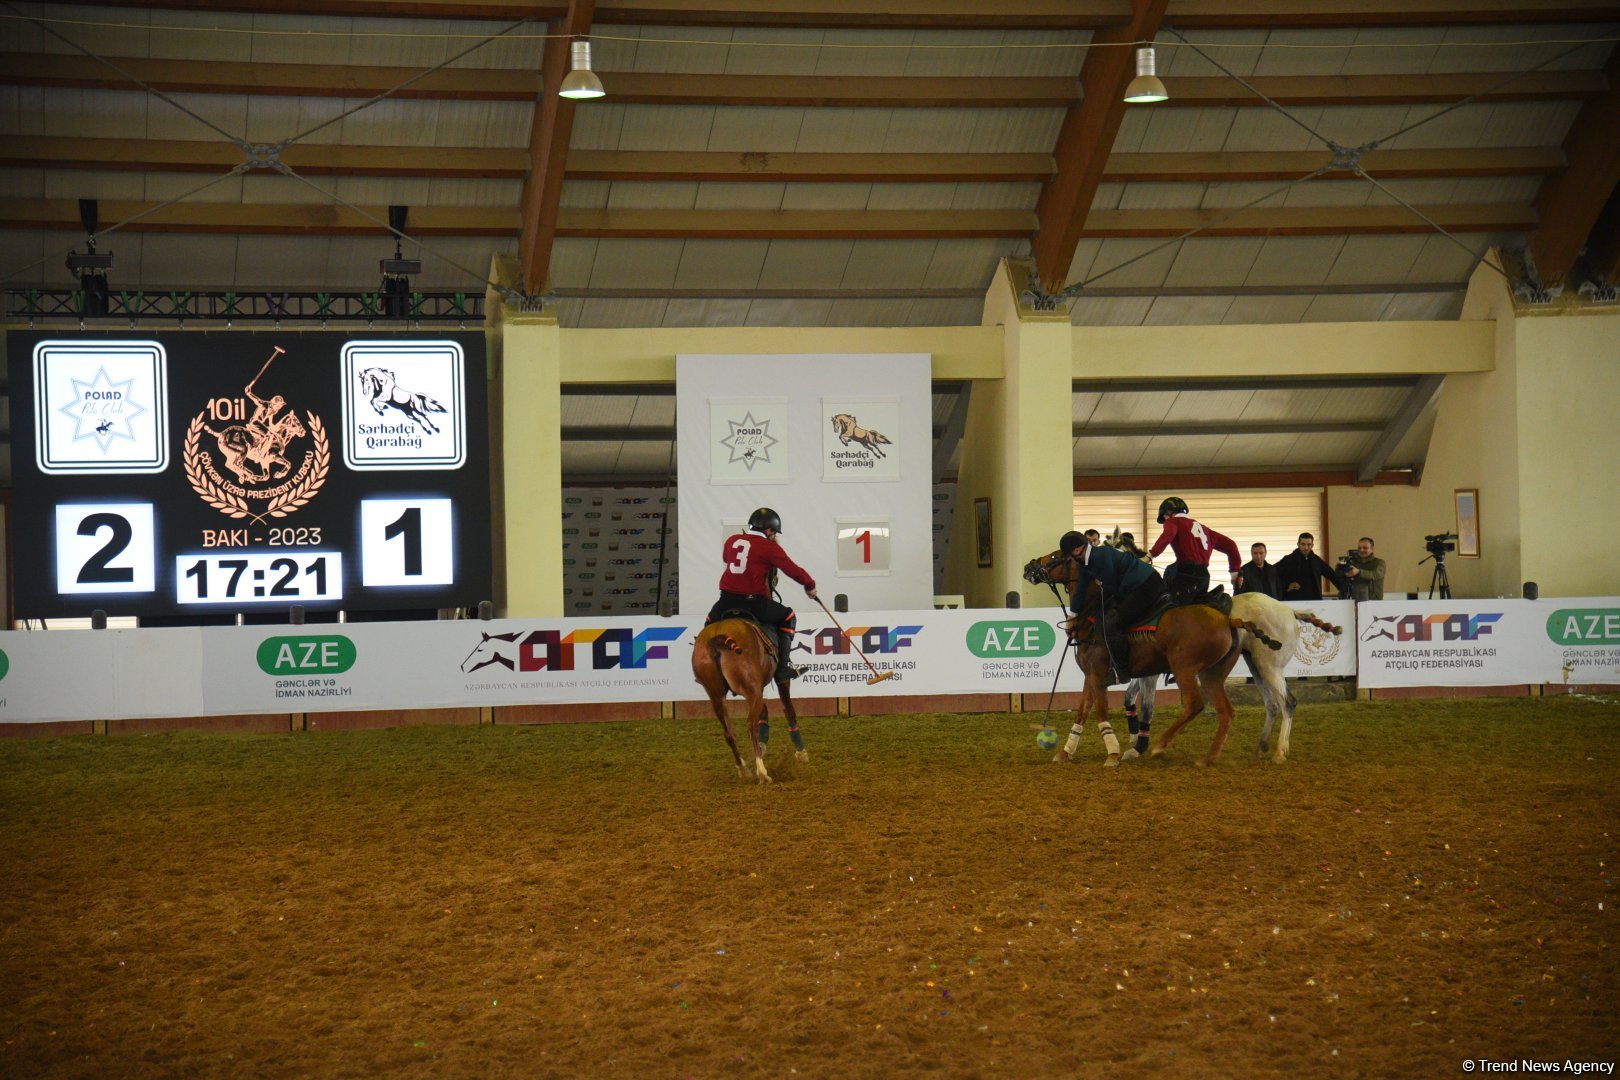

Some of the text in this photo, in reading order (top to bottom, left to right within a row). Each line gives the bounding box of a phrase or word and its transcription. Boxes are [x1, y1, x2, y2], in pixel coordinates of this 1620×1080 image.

[85, 391, 122, 400] POLAD
[358, 423, 415, 437] Sərhədçi
[366, 434, 422, 449] Qarabağ
[247, 481, 294, 499] PREZİDENT
[292, 450, 314, 485] KUBOKU
[202, 529, 248, 547] BAKI
[269, 527, 322, 546] 2023
[384, 507, 423, 576] 1
[1191, 521, 1209, 551] 4
[76, 512, 135, 584] 2
[855, 530, 871, 563] 1
[729, 538, 751, 574] 3
[185, 556, 327, 598] 17:21
[1562, 615, 1620, 639] AZE
[982, 627, 1040, 651] AZE
[274, 642, 339, 669] AZE
[1371, 647, 1497, 658] AZƏRBAYCAN RESPUBLİKASI
[1563, 650, 1606, 658] GƏNCLƏR
[982, 662, 1025, 670] GƏNCLƏR
[1385, 658, 1483, 670] ATÇILIQ FEDERASİYASI
[802, 674, 837, 684] ATÇILIQ
[982, 669, 1055, 679] İDMAN NAZİRLİYİ
[275, 680, 321, 688] GƏNCLƏR
[275, 686, 352, 698] İDMAN NAZİRLİYİ
